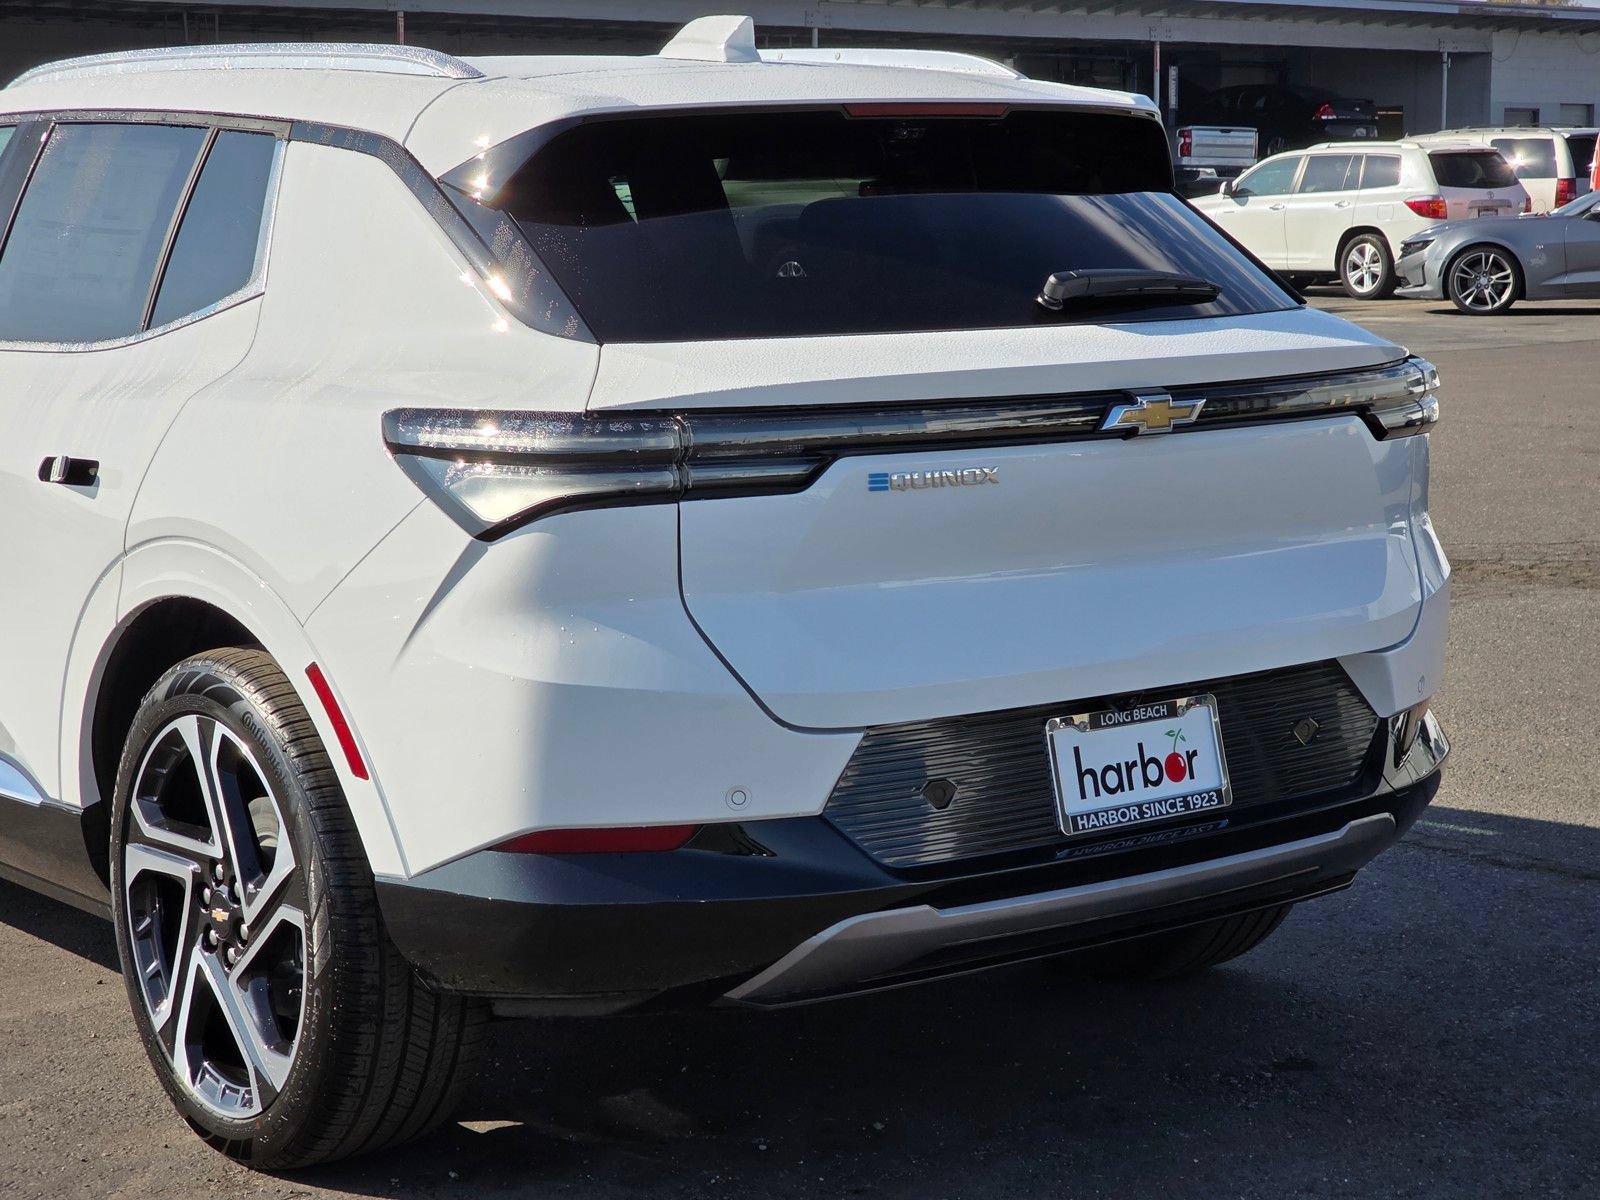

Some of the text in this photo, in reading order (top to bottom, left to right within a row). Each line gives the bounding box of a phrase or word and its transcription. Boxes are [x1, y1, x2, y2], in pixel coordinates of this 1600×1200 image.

[868, 467, 999, 492] EQUINOX
[1100, 705, 1168, 726] LONG BEACH
[1073, 743, 1198, 800] harbor
[1077, 792, 1218, 830] HARBOR SINCE 1923
